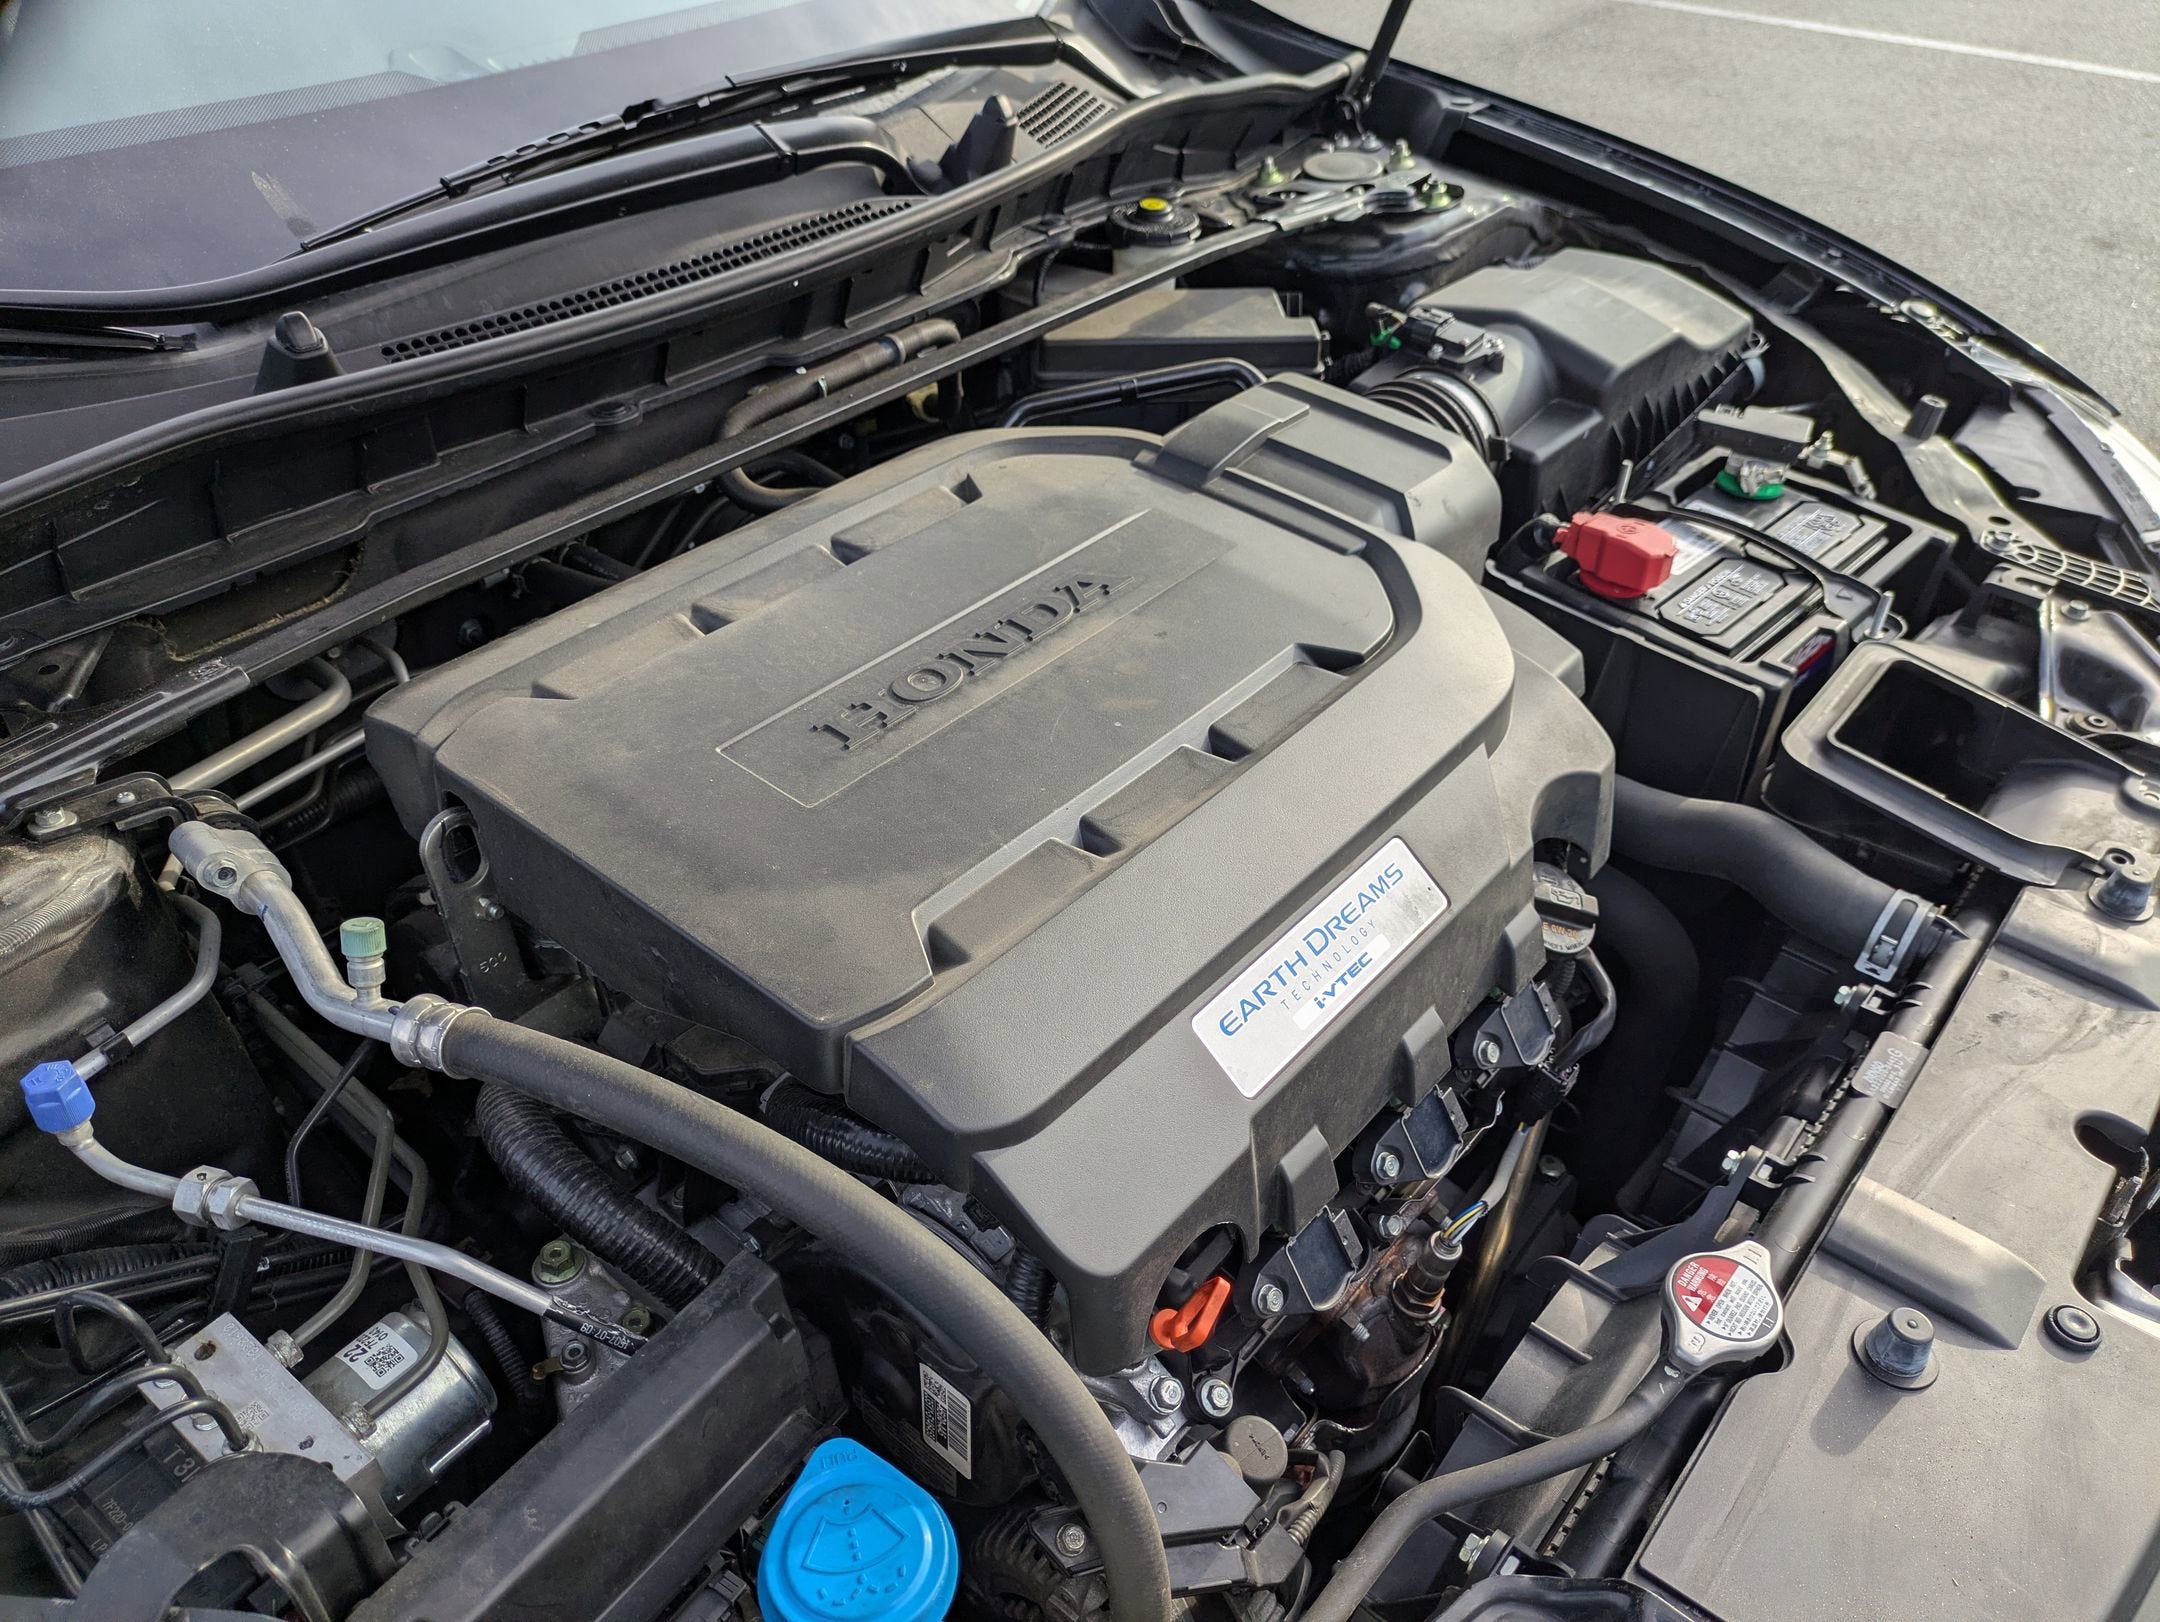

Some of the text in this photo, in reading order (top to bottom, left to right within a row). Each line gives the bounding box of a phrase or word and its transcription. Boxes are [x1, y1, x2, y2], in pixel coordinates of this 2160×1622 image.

[808, 574, 1136, 750] HONDA
[1218, 862, 1404, 1037] EARTH DREAMS
[1280, 918, 1377, 1011] TECHNOLOGY
[1313, 951, 1374, 1009] i-VTEC
[1677, 1261, 1699, 1287] DANGER
[1762, 1316, 1775, 1329] 1.1
[343, 1344, 368, 1362] 22
